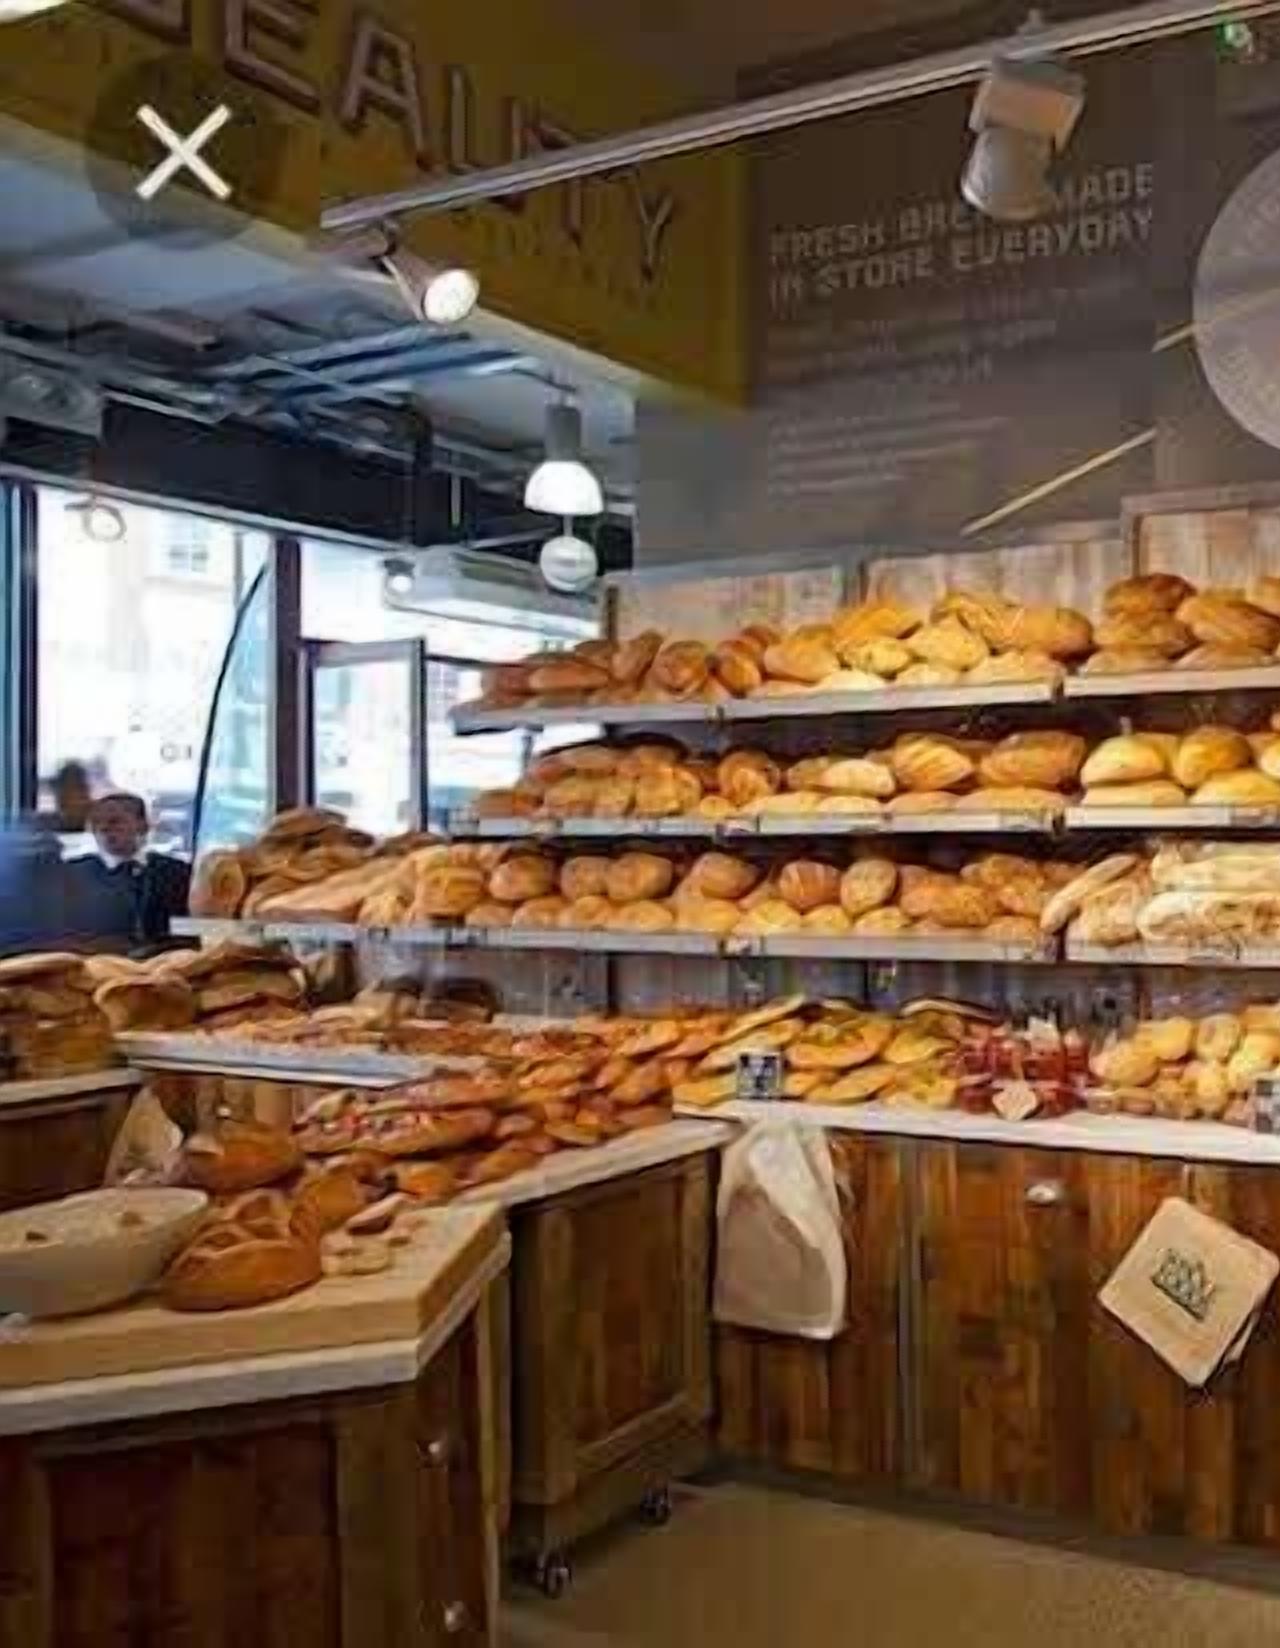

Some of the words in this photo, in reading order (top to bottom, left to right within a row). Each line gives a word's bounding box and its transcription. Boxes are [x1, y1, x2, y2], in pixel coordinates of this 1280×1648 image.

[769, 221, 885, 264] FRESH
[812, 246, 935, 298] STORE
[952, 207, 1154, 273] EVERYDAY
